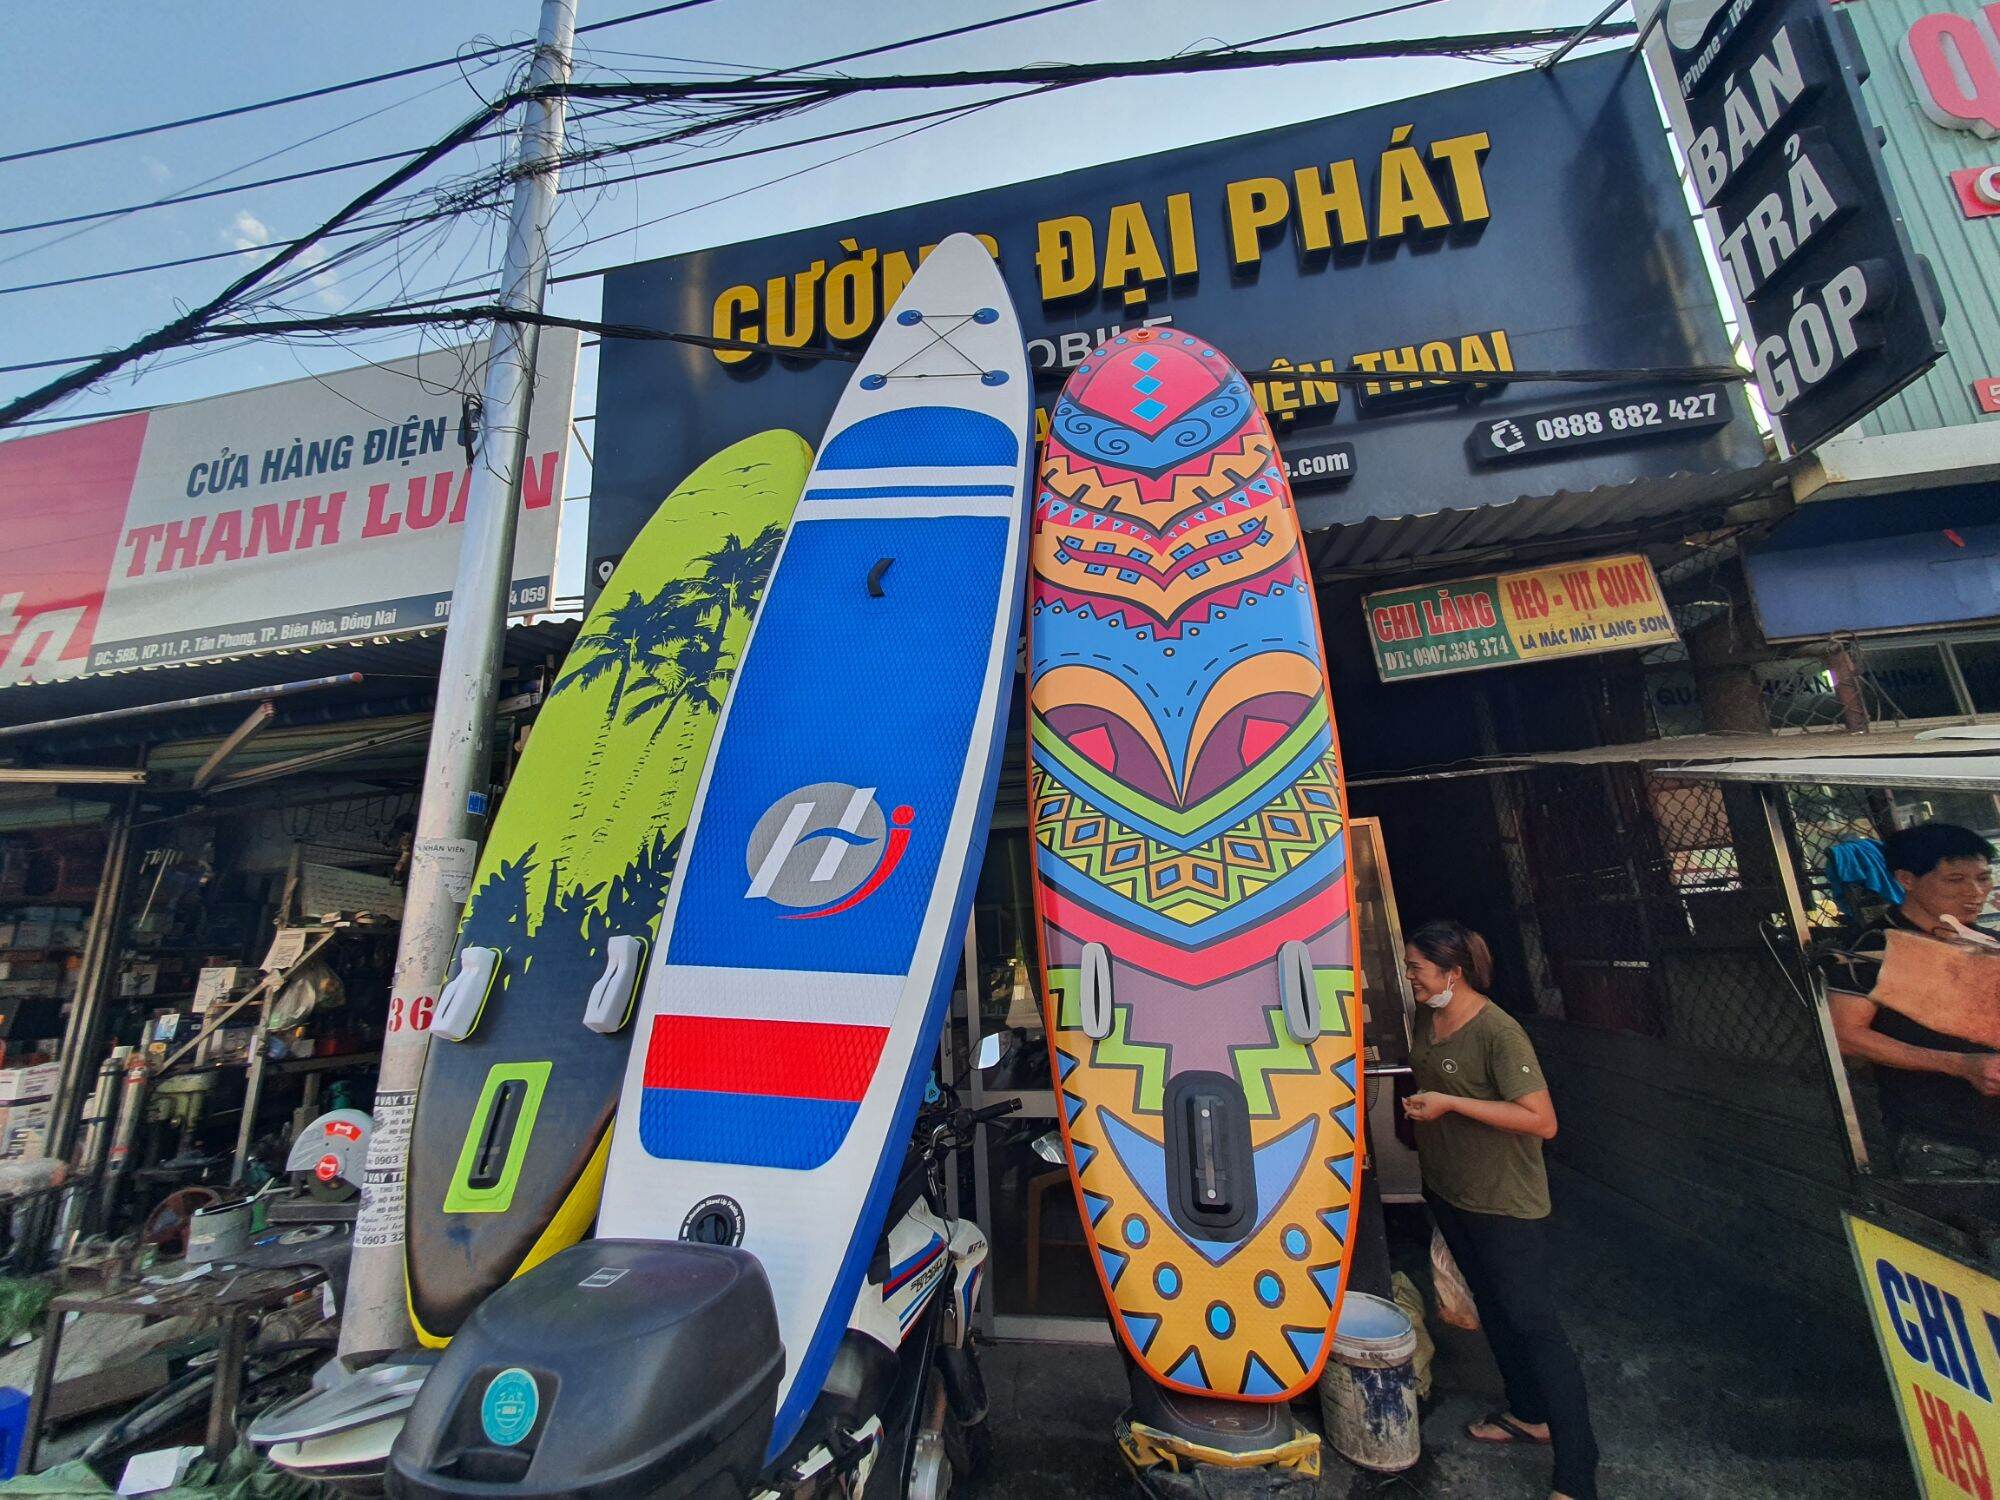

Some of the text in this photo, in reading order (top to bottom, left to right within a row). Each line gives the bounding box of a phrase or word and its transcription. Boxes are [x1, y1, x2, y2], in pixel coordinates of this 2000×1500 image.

[1680, 34, 1721, 97] iPhone
[1688, 25, 1806, 206] BÁN
[1035, 192, 1200, 308] ĐẠI
[1226, 123, 1492, 266] PHÁT
[1719, 132, 1839, 302] TRẢ
[1353, 330, 1514, 396] THOẠI
[1753, 265, 1869, 415] GÓP
[1536, 392, 1717, 442] 0888 882 427
[186, 447, 250, 500] CỬA
[259, 430, 353, 486] HÀNG
[362, 414, 448, 467] ĐIỆN
[123, 489, 349, 580] THANH
[520, 585, 546, 604] 059
[1373, 589, 1498, 643] CHI LĂNG
[1506, 576, 1550, 621] HEO
[1559, 569, 1598, 621] VỊT
[1596, 560, 1653, 609] QUAY
[141, 640, 178, 661] KP.11,
[179, 638, 191, 655] P.
[194, 633, 215, 652] Tân
[260, 626, 279, 643] TP.
[280, 620, 309, 641] Biên
[310, 616, 338, 637] Hòa,
[340, 611, 372, 633] Đồng
[374, 607, 398, 626] Nai
[1413, 639, 1480, 666] 0907.336
[1480, 635, 1510, 657] 374
[388, 995, 434, 1032] 36
[374, 1155, 399, 1166] 0903
[361, 1234, 387, 1246] 0903
[1875, 1258, 1993, 1404] CHI
[1912, 1382, 1994, 1500] HEO
